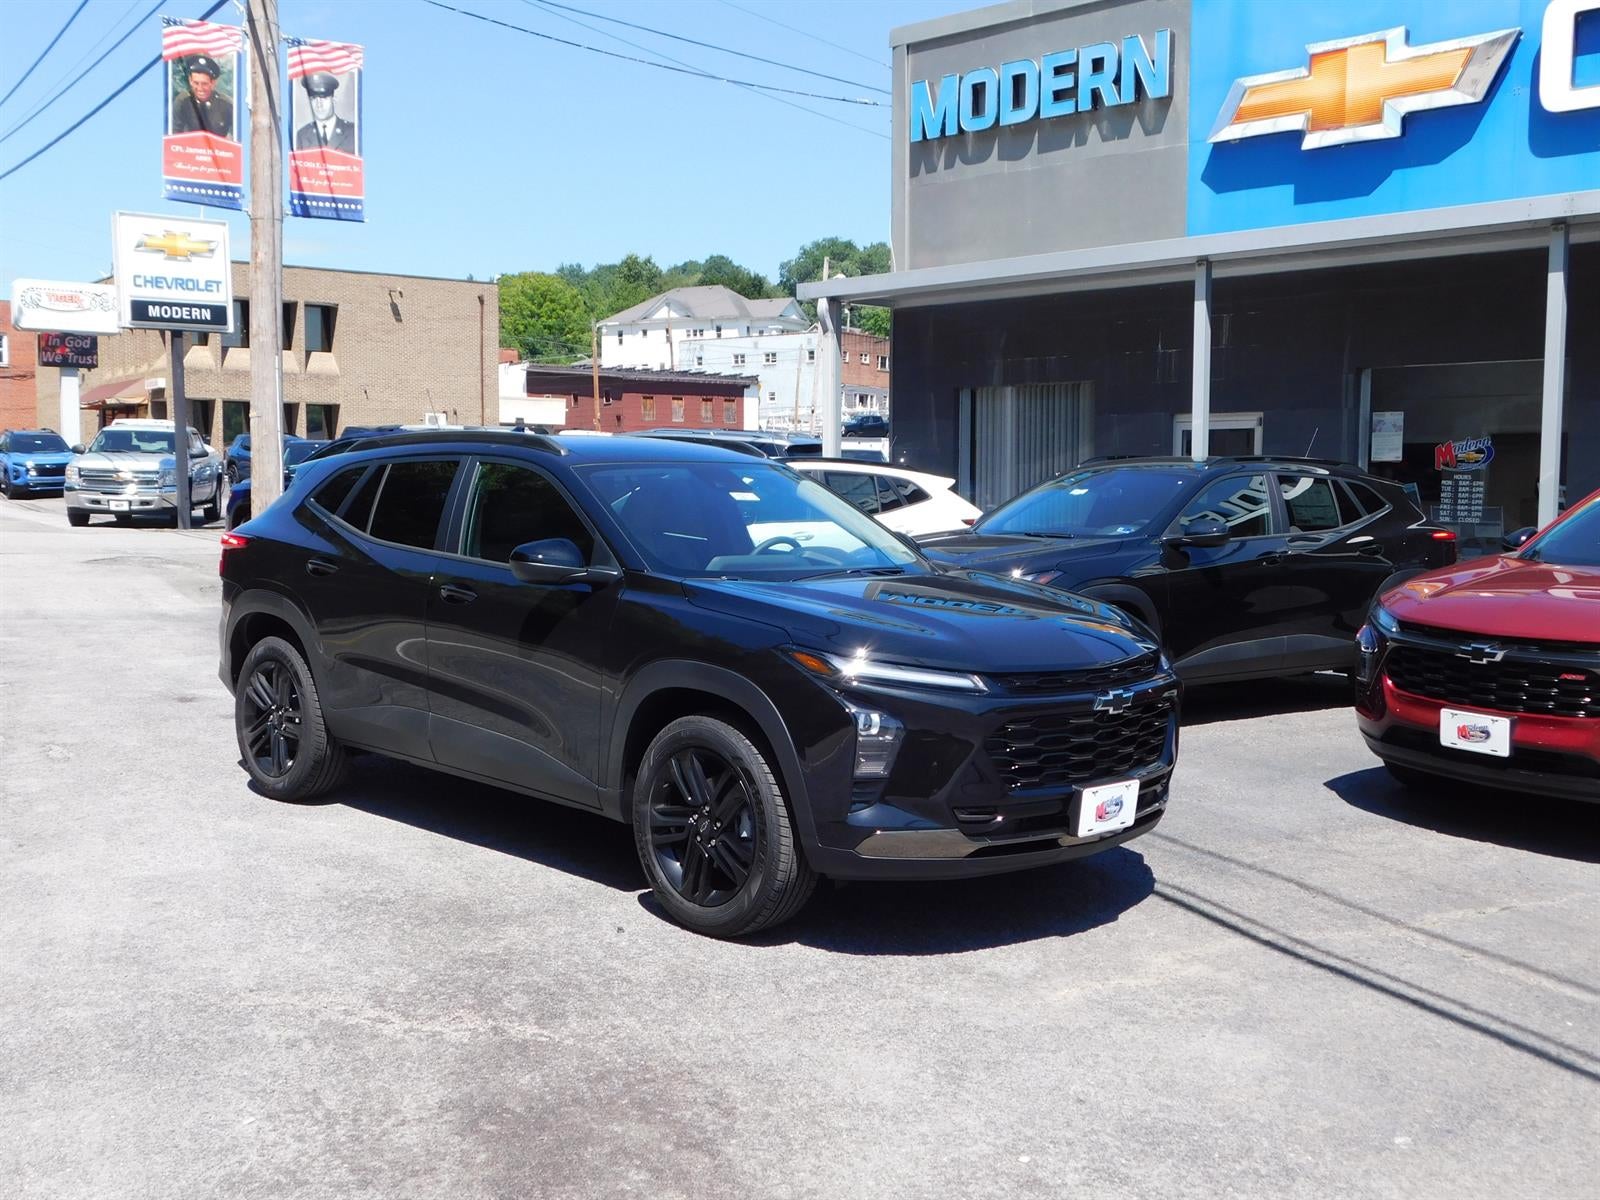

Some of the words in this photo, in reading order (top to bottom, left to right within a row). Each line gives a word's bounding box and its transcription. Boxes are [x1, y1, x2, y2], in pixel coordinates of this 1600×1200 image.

[910, 28, 1171, 143] MODERN
[133, 274, 222, 293] CHEVROLET
[148, 305, 211, 320] MODERN
[48, 335, 60, 347] In
[64, 336, 91, 349] God
[42, 351, 63, 363] We
[67, 352, 97, 365] Trust
[1434, 436, 1491, 470] Modern
